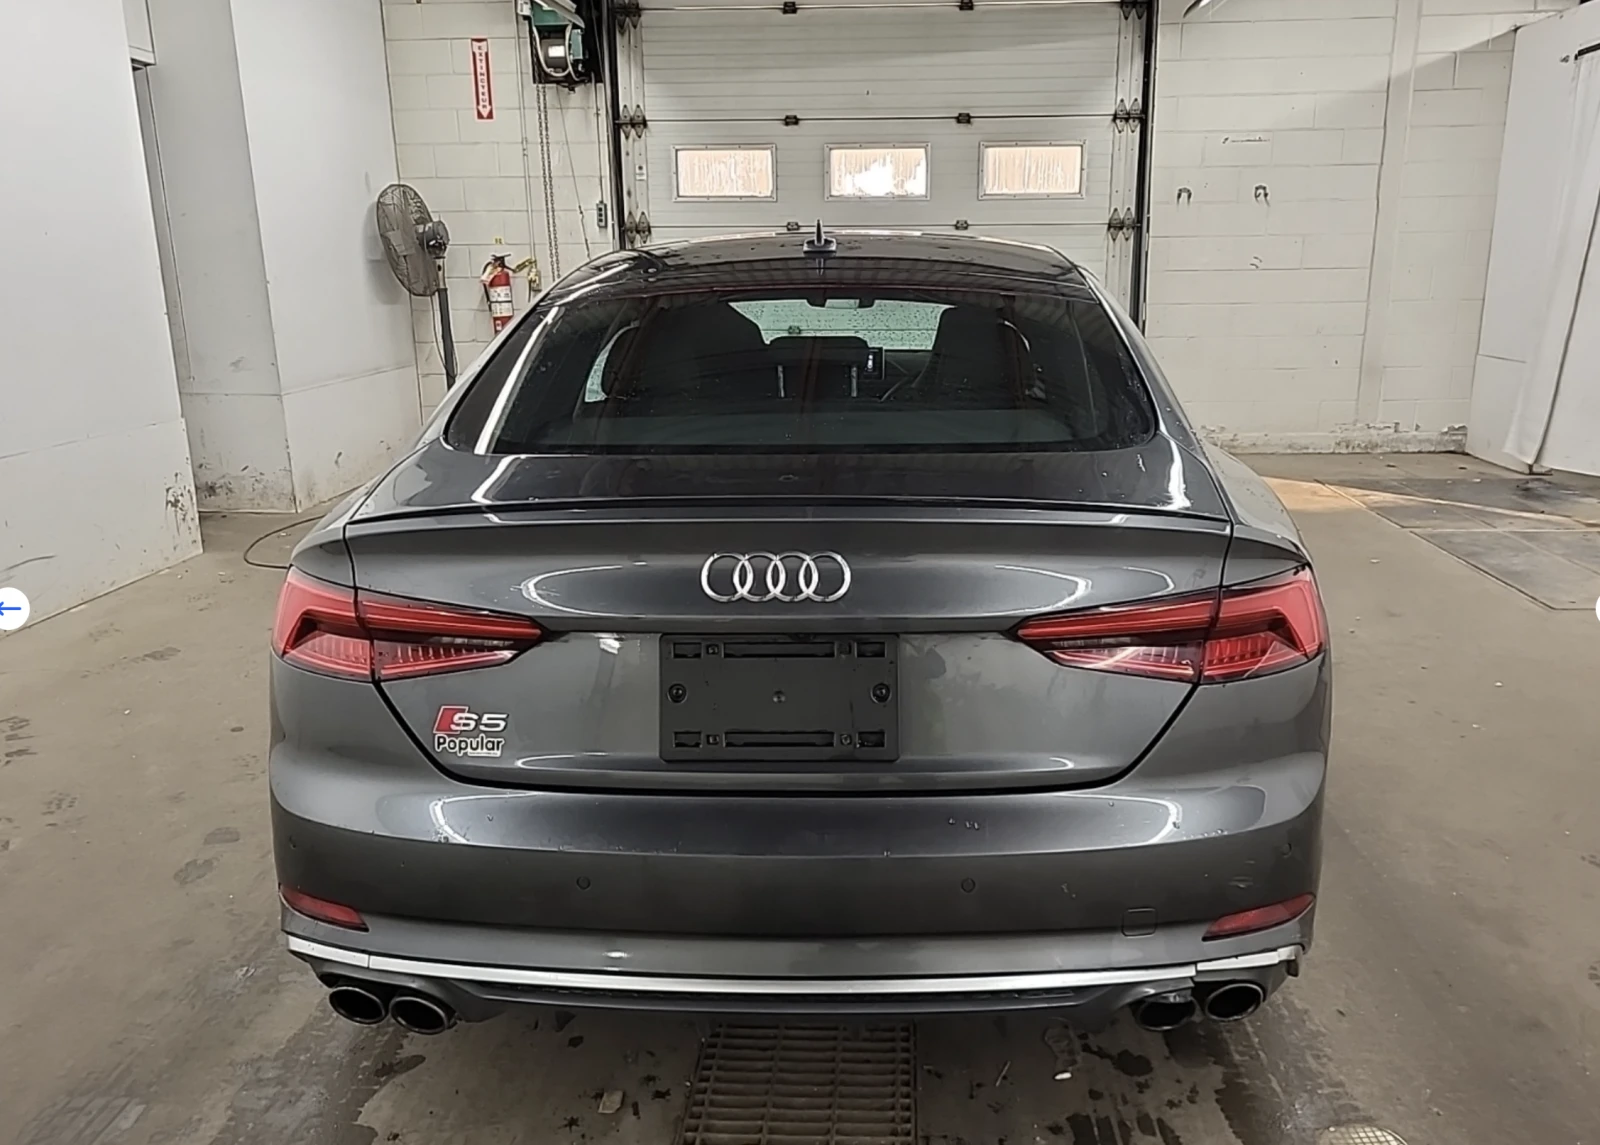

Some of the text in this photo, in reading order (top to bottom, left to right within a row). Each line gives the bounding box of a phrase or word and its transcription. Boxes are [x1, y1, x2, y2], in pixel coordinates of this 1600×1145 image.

[478, 45, 488, 109] EXTINCTEUR
[450, 712, 508, 732] S5
[436, 735, 503, 755] Popular
